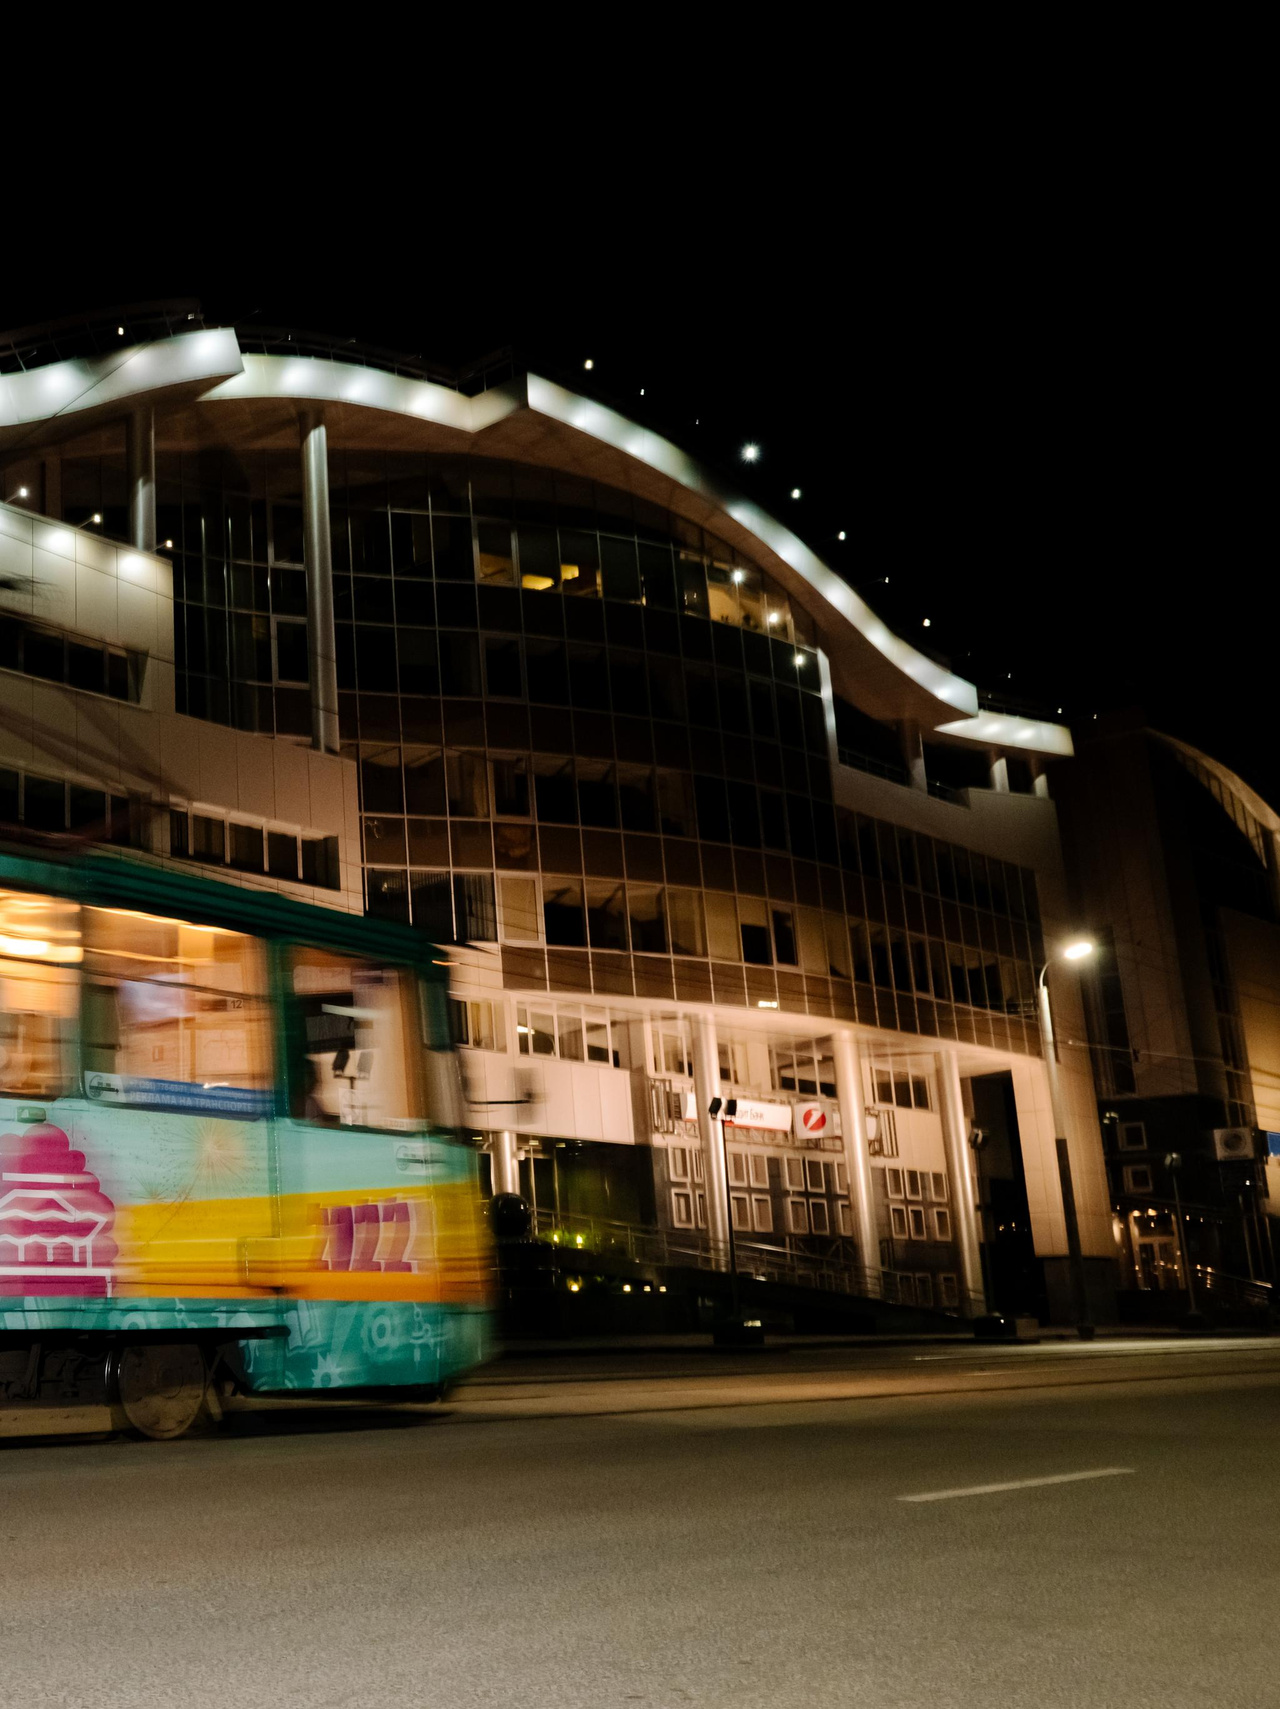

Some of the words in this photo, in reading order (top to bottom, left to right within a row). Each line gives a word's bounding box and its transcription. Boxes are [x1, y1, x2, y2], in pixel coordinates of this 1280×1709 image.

[230, 999, 243, 1009] 12
[129, 1091, 178, 1106] РЕКЛАМА
[179, 1096, 192, 1107] НА
[194, 1098, 253, 1113] ТРАНСПОРТЕ
